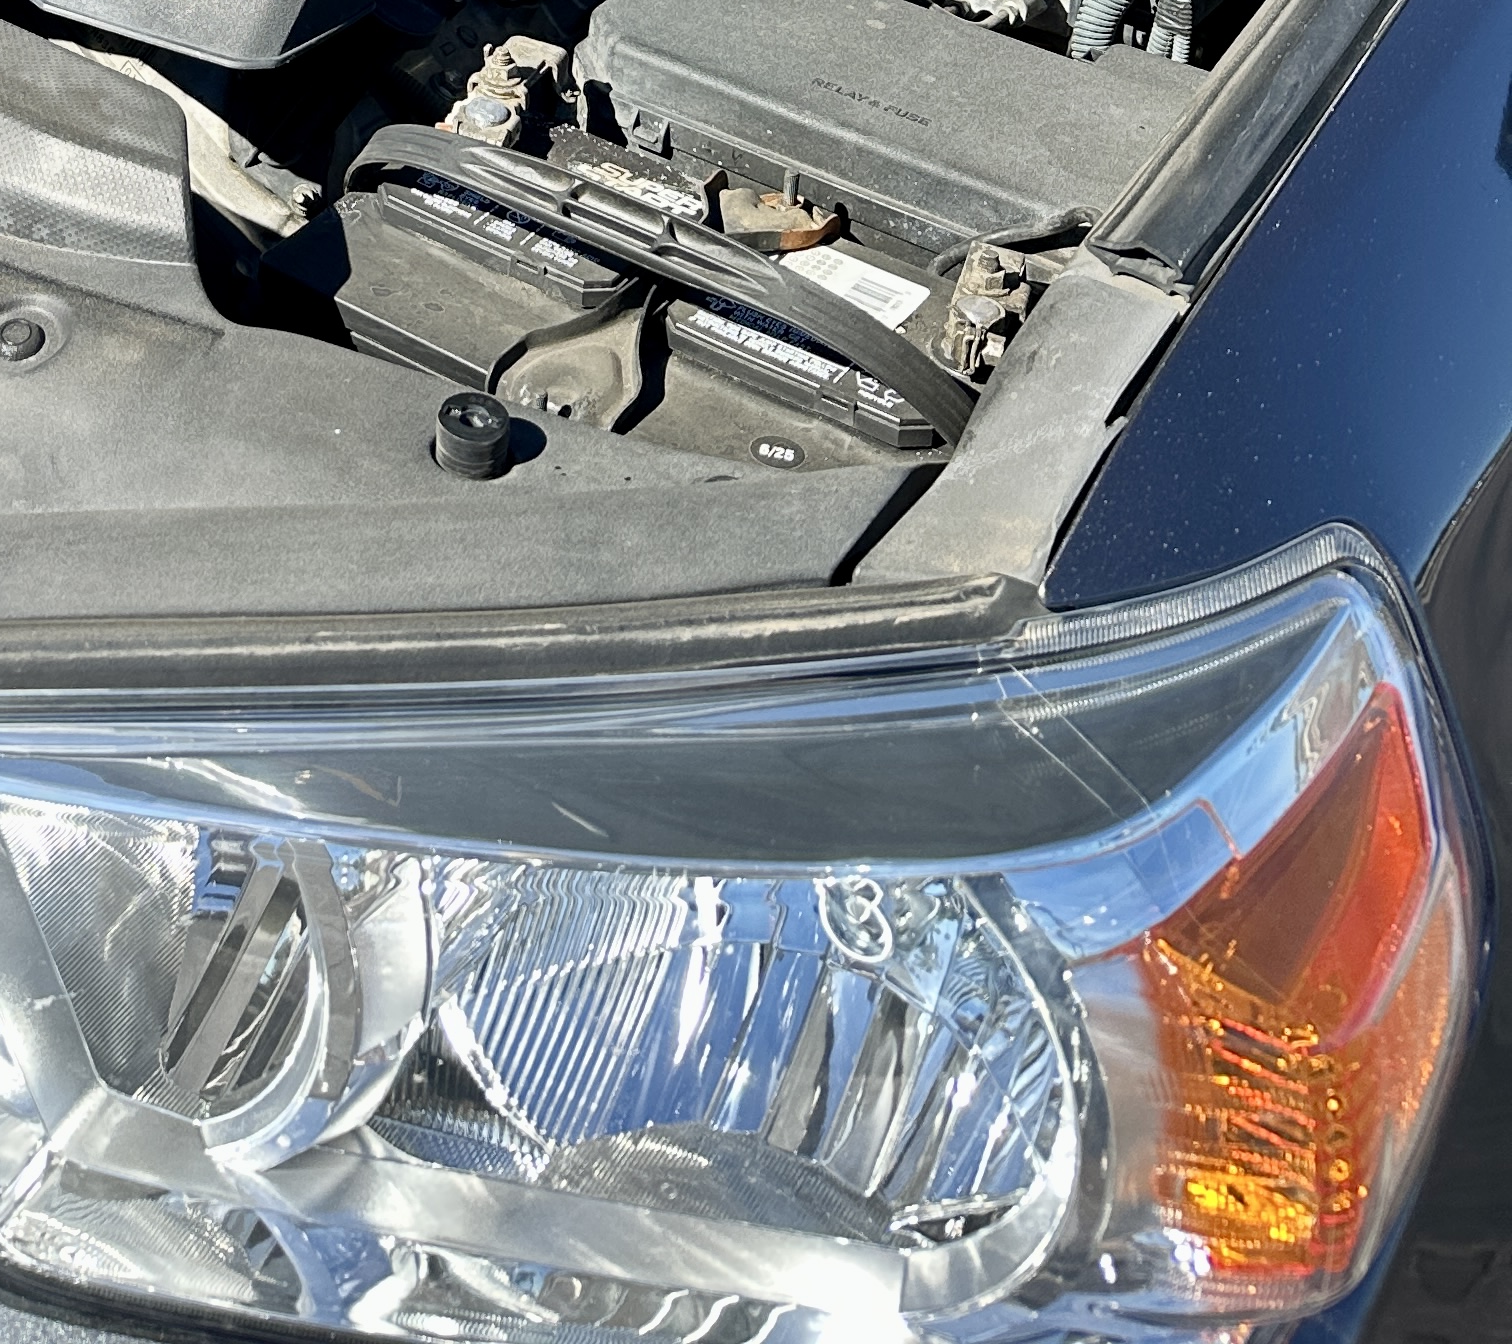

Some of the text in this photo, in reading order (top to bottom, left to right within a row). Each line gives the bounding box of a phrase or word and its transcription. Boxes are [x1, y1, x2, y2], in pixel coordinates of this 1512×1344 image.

[811, 78, 869, 102] RELAY
[883, 105, 932, 127] FUSE
[576, 163, 698, 215] START
[599, 162, 702, 210] SUPER
[758, 442, 795, 462] 6/25
